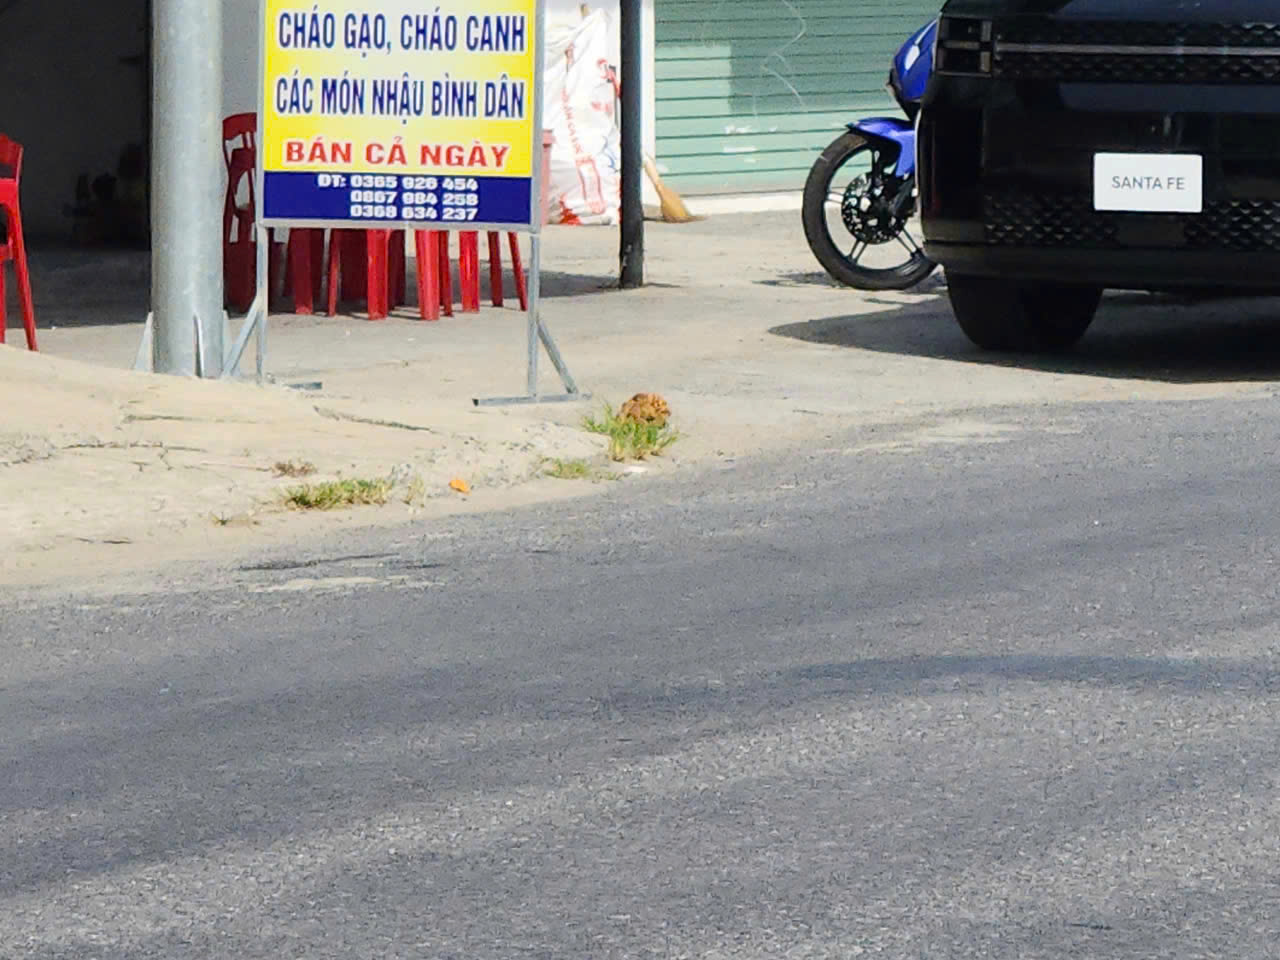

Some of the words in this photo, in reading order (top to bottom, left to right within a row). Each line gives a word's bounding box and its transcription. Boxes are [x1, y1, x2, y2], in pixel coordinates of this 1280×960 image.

[279, 4, 335, 49] CHÁO
[344, 13, 391, 58] GẠO,
[400, 6, 457, 51] CHÁO
[466, 14, 525, 52] CANH
[276, 69, 314, 115] CÁC
[321, 70, 365, 115] MÓN
[372, 71, 424, 125] NHẬU
[431, 73, 477, 117] BÌNH
[485, 73, 525, 118] DÂN
[286, 136, 352, 163] BÁN
[365, 135, 408, 165] CẢ
[420, 140, 509, 167] NGÀY
[1112, 175, 1163, 190] SANTA
[1167, 177, 1185, 190] FE
